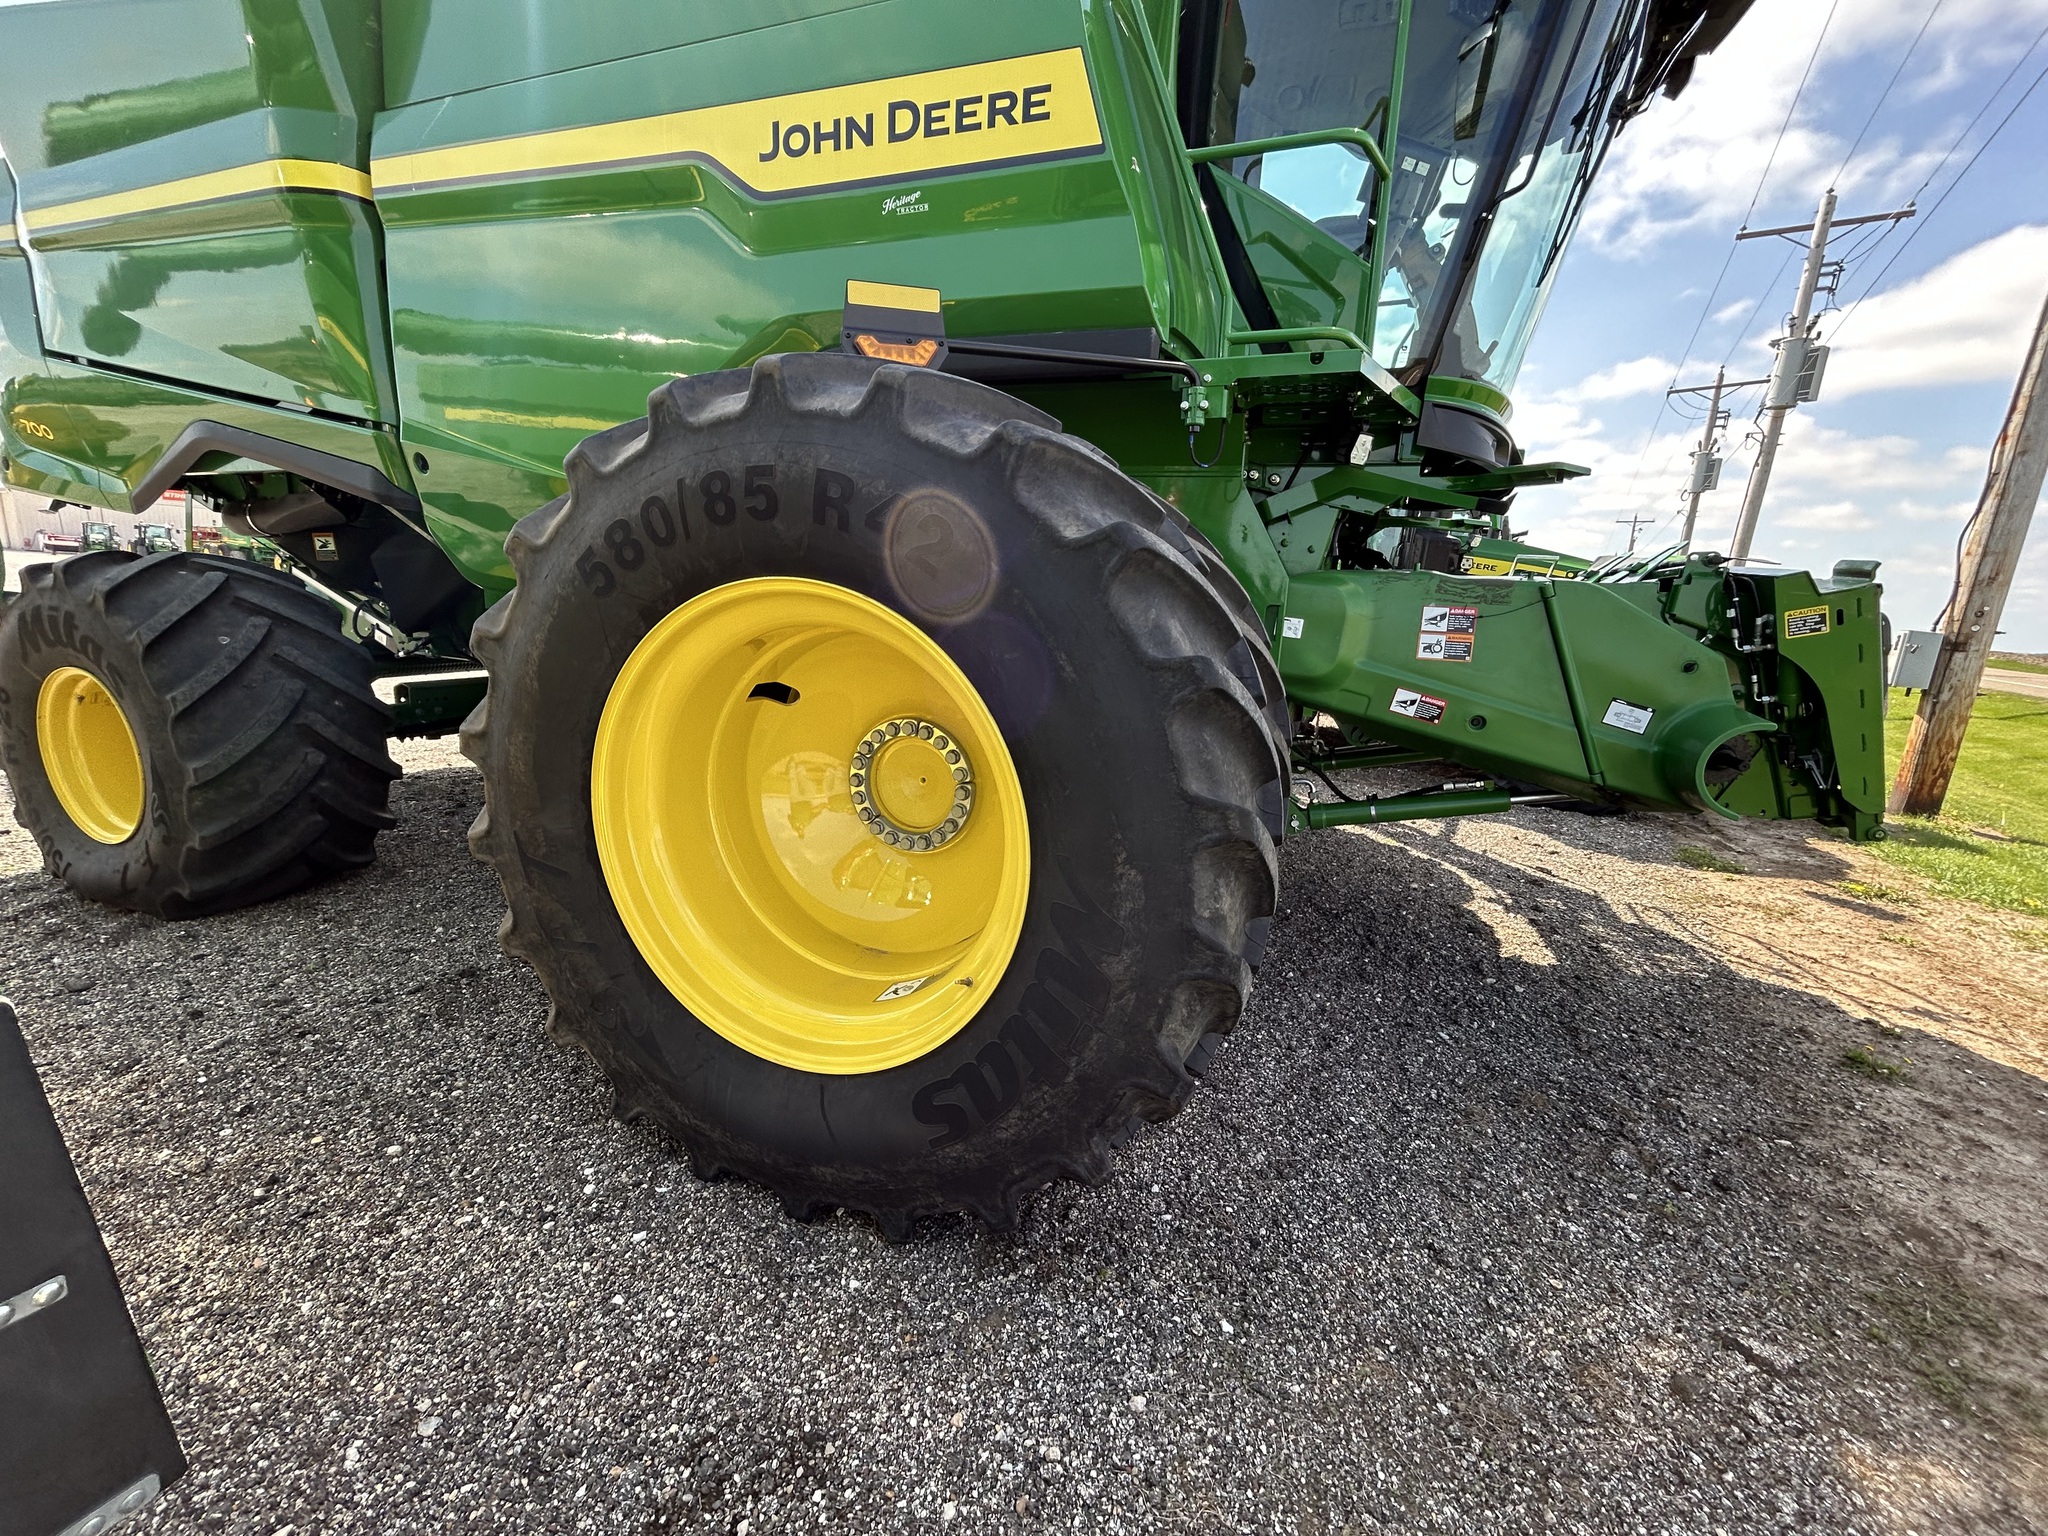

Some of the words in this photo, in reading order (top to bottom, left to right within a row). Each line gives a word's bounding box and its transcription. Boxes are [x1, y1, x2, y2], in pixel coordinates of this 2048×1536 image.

[759, 112, 874, 163] JOHN
[887, 83, 1053, 144] DEERE
[881, 190, 922, 216] Heritage
[896, 203, 930, 215] TRACTOR
[19, 418, 54, 440] 700
[576, 464, 779, 599] 580/85
[1793, 607, 1827, 617] CAUTION
[912, 853, 1126, 1152] Mitas
